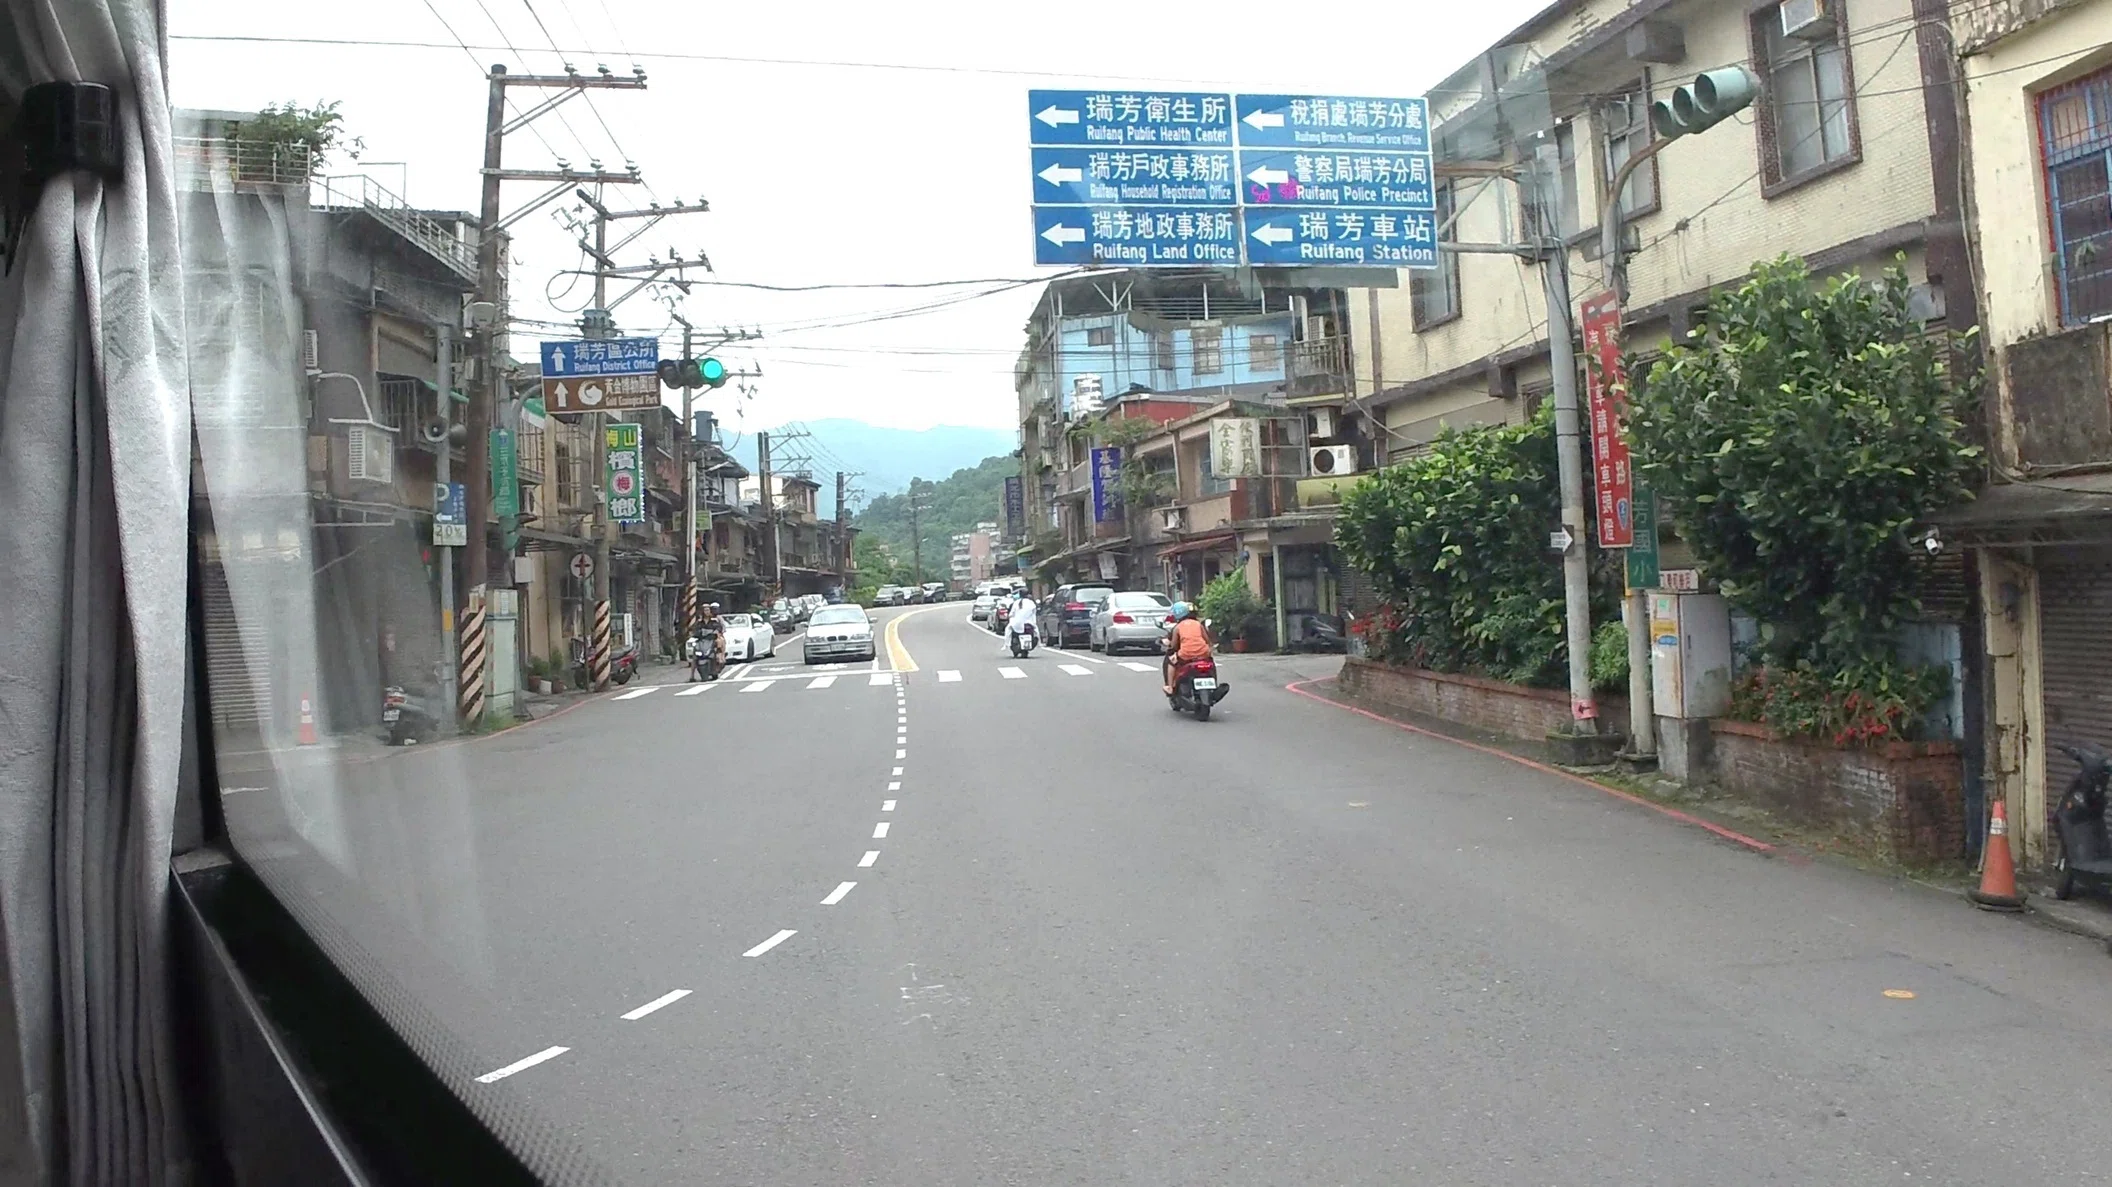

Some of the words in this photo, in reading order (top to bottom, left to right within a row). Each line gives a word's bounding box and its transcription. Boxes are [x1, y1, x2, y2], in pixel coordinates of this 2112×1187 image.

[1086, 95, 1226, 123] 瑞芳衛生所
[1087, 125, 1123, 144] Ruifang
[1127, 126, 1156, 141] Public
[1160, 127, 1191, 142] Health
[1195, 128, 1227, 143] Center
[1295, 156, 1426, 184] 警察局瑞芳分局
[1122, 184, 1159, 199] Household
[1162, 185, 1206, 202] Registration
[1210, 186, 1231, 200] Office
[1296, 186, 1339, 204] Ruifang
[1344, 186, 1377, 201] Police
[1382, 187, 1428, 203] Precinct
[1092, 211, 1233, 240] 瑞芳地政事務所
[1300, 212, 1431, 242] 瑞芳車站
[1093, 243, 1147, 263] Ruifang
[1153, 243, 1187, 259] Land
[1194, 244, 1235, 259] Office
[1301, 244, 1364, 263] Ruifang
[1373, 245, 1433, 260] Station
[573, 340, 655, 361] 瑞芳區公所
[574, 362, 600, 373] Ruifang
[603, 360, 630, 371] District
[633, 360, 655, 369] Office
